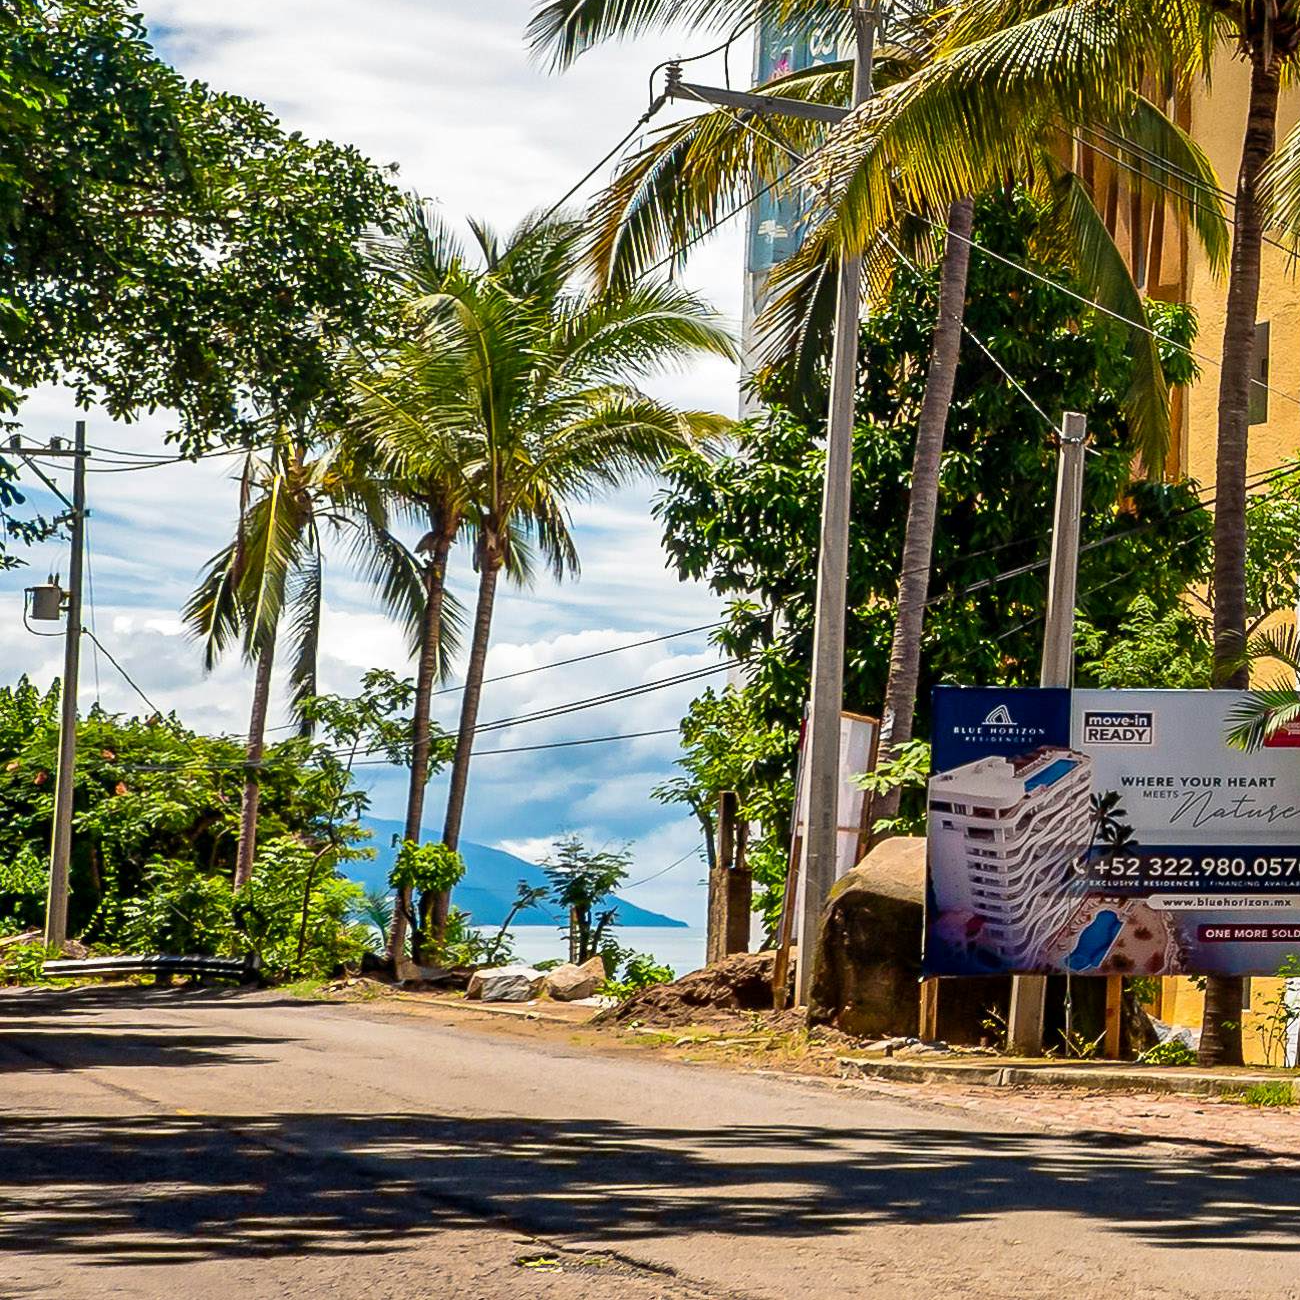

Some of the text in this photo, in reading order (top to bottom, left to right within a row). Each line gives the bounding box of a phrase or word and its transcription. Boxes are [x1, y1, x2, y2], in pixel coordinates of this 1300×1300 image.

[1088, 714, 1148, 726] move-in
[953, 726, 983, 735] BLUE
[1088, 728, 1148, 742] READY
[1121, 777, 1277, 788] WHERE YOUR HEART
[1143, 789, 1179, 798] MEETS
[1094, 857, 1140, 876] +52
[1162, 897, 1292, 908] www.bluehorizon.mx
[1205, 929, 1231, 939] ONE
[1234, 929, 1269, 939] MORE
